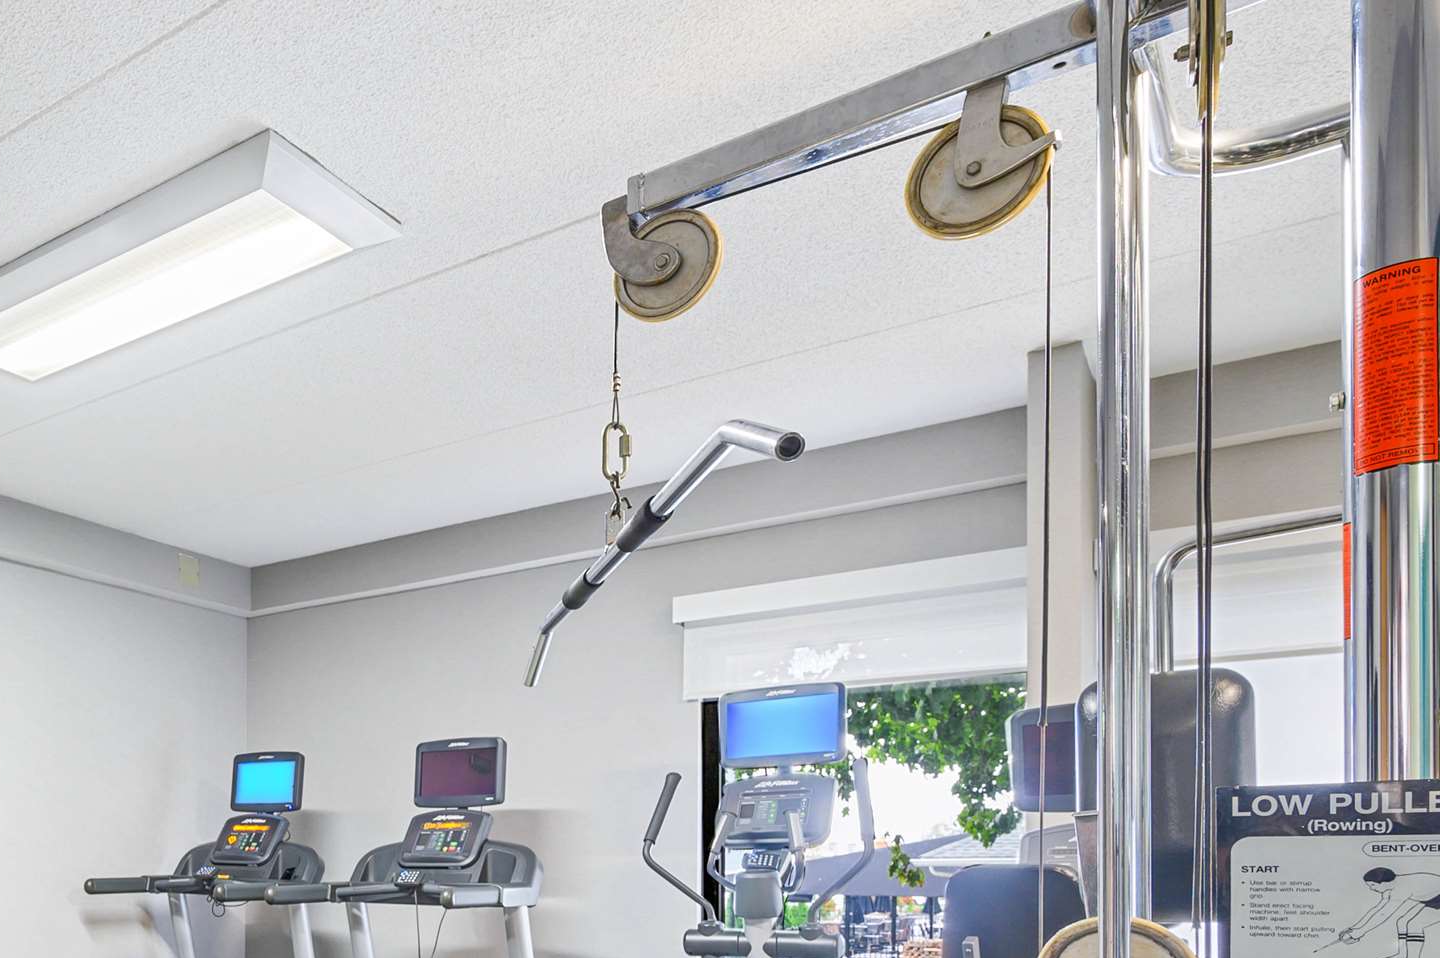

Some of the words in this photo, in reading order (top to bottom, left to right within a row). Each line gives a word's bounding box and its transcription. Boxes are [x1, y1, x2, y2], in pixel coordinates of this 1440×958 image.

[1363, 265, 1421, 288] WARNING
[1387, 448, 1422, 457] REMO
[1231, 793, 1313, 817] LOW
[1307, 818, 1393, 834] (Rowing)
[1371, 843, 1440, 853] BENT-OVE
[1241, 865, 1280, 873] START
